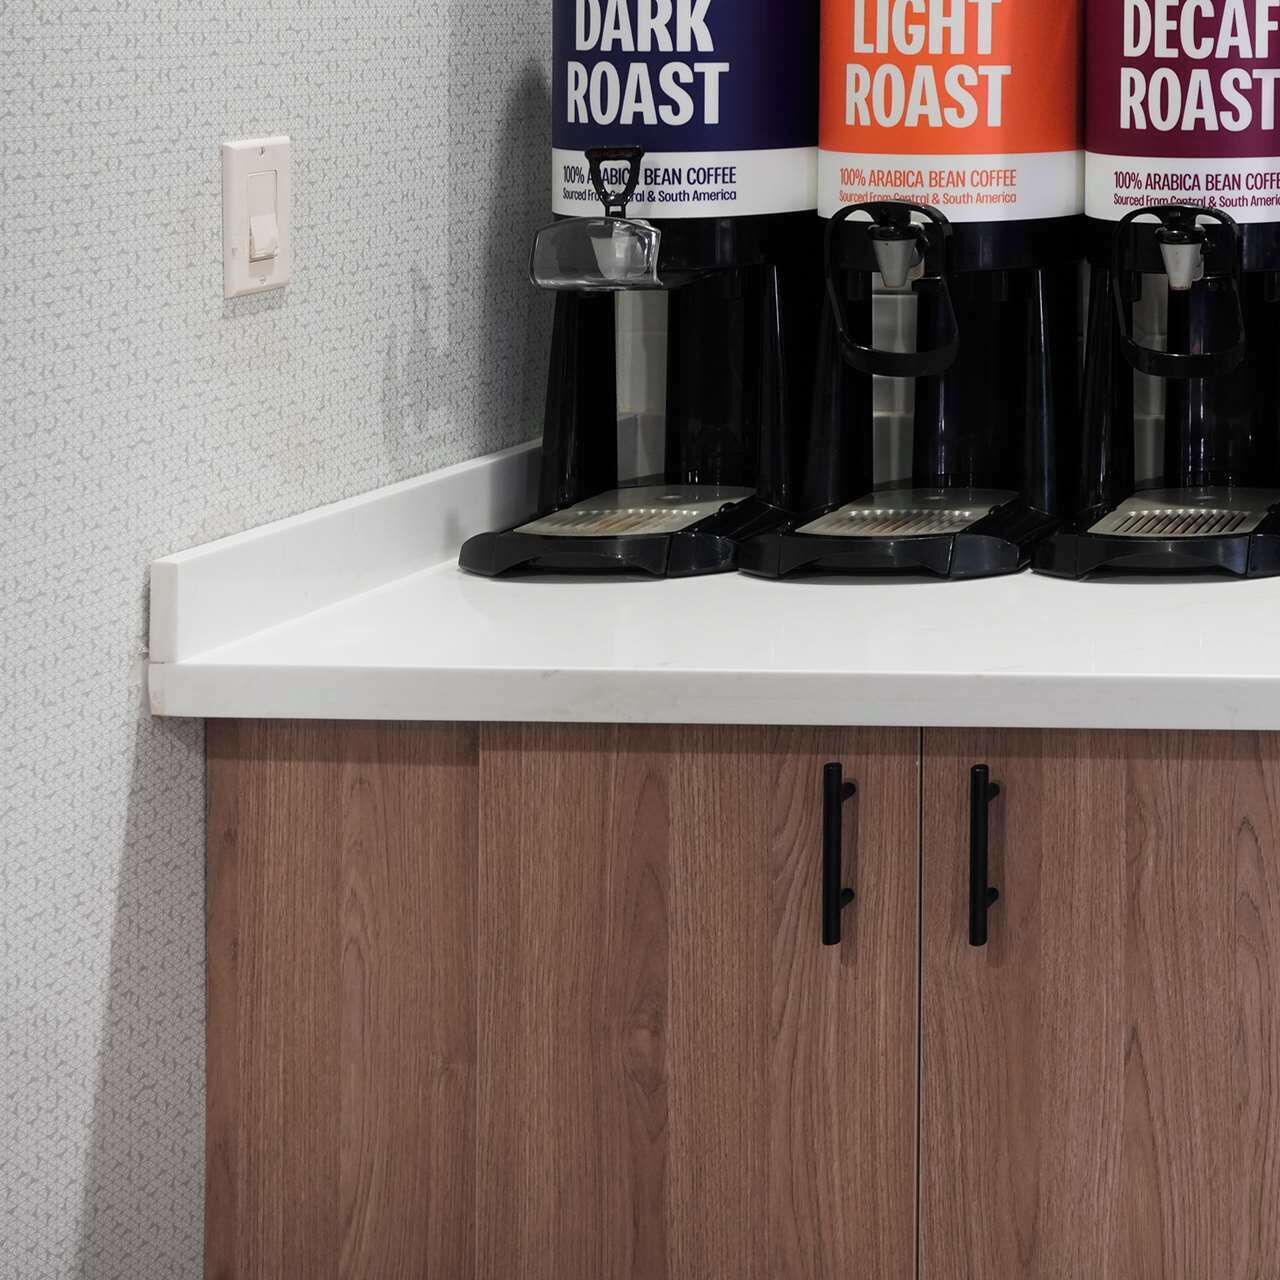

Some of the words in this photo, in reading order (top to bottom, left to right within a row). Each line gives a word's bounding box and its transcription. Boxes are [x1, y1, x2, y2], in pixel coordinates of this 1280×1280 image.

[567, 62, 730, 126] ROAST
[845, 64, 1012, 129] ROAST
[563, 166, 585, 184] 100%
[644, 167, 682, 186] BEAN
[686, 166, 737, 185] COFFEE
[839, 167, 866, 186] 100%
[868, 169, 924, 188] ARABICA
[928, 170, 966, 188] BEAN
[970, 169, 1017, 187] COFFEE
[1114, 170, 1142, 189] 100%
[1145, 172, 1201, 191] ARABICA
[1205, 173, 1241, 191] BEAN
[562, 188, 587, 201] Sourced
[588, 189, 601, 201] Fro
[647, 191, 656, 202] &
[659, 189, 690, 202] South
[692, 189, 737, 201] America
[839, 190, 869, 203] Sourced
[931, 193, 941, 205] &
[943, 192, 972, 205] South
[975, 191, 1017, 203] America
[1113, 193, 1144, 206] Sourced
[1146, 194, 1169, 207] From
[1208, 196, 1217, 208] &
[1219, 195, 1249, 208] South
